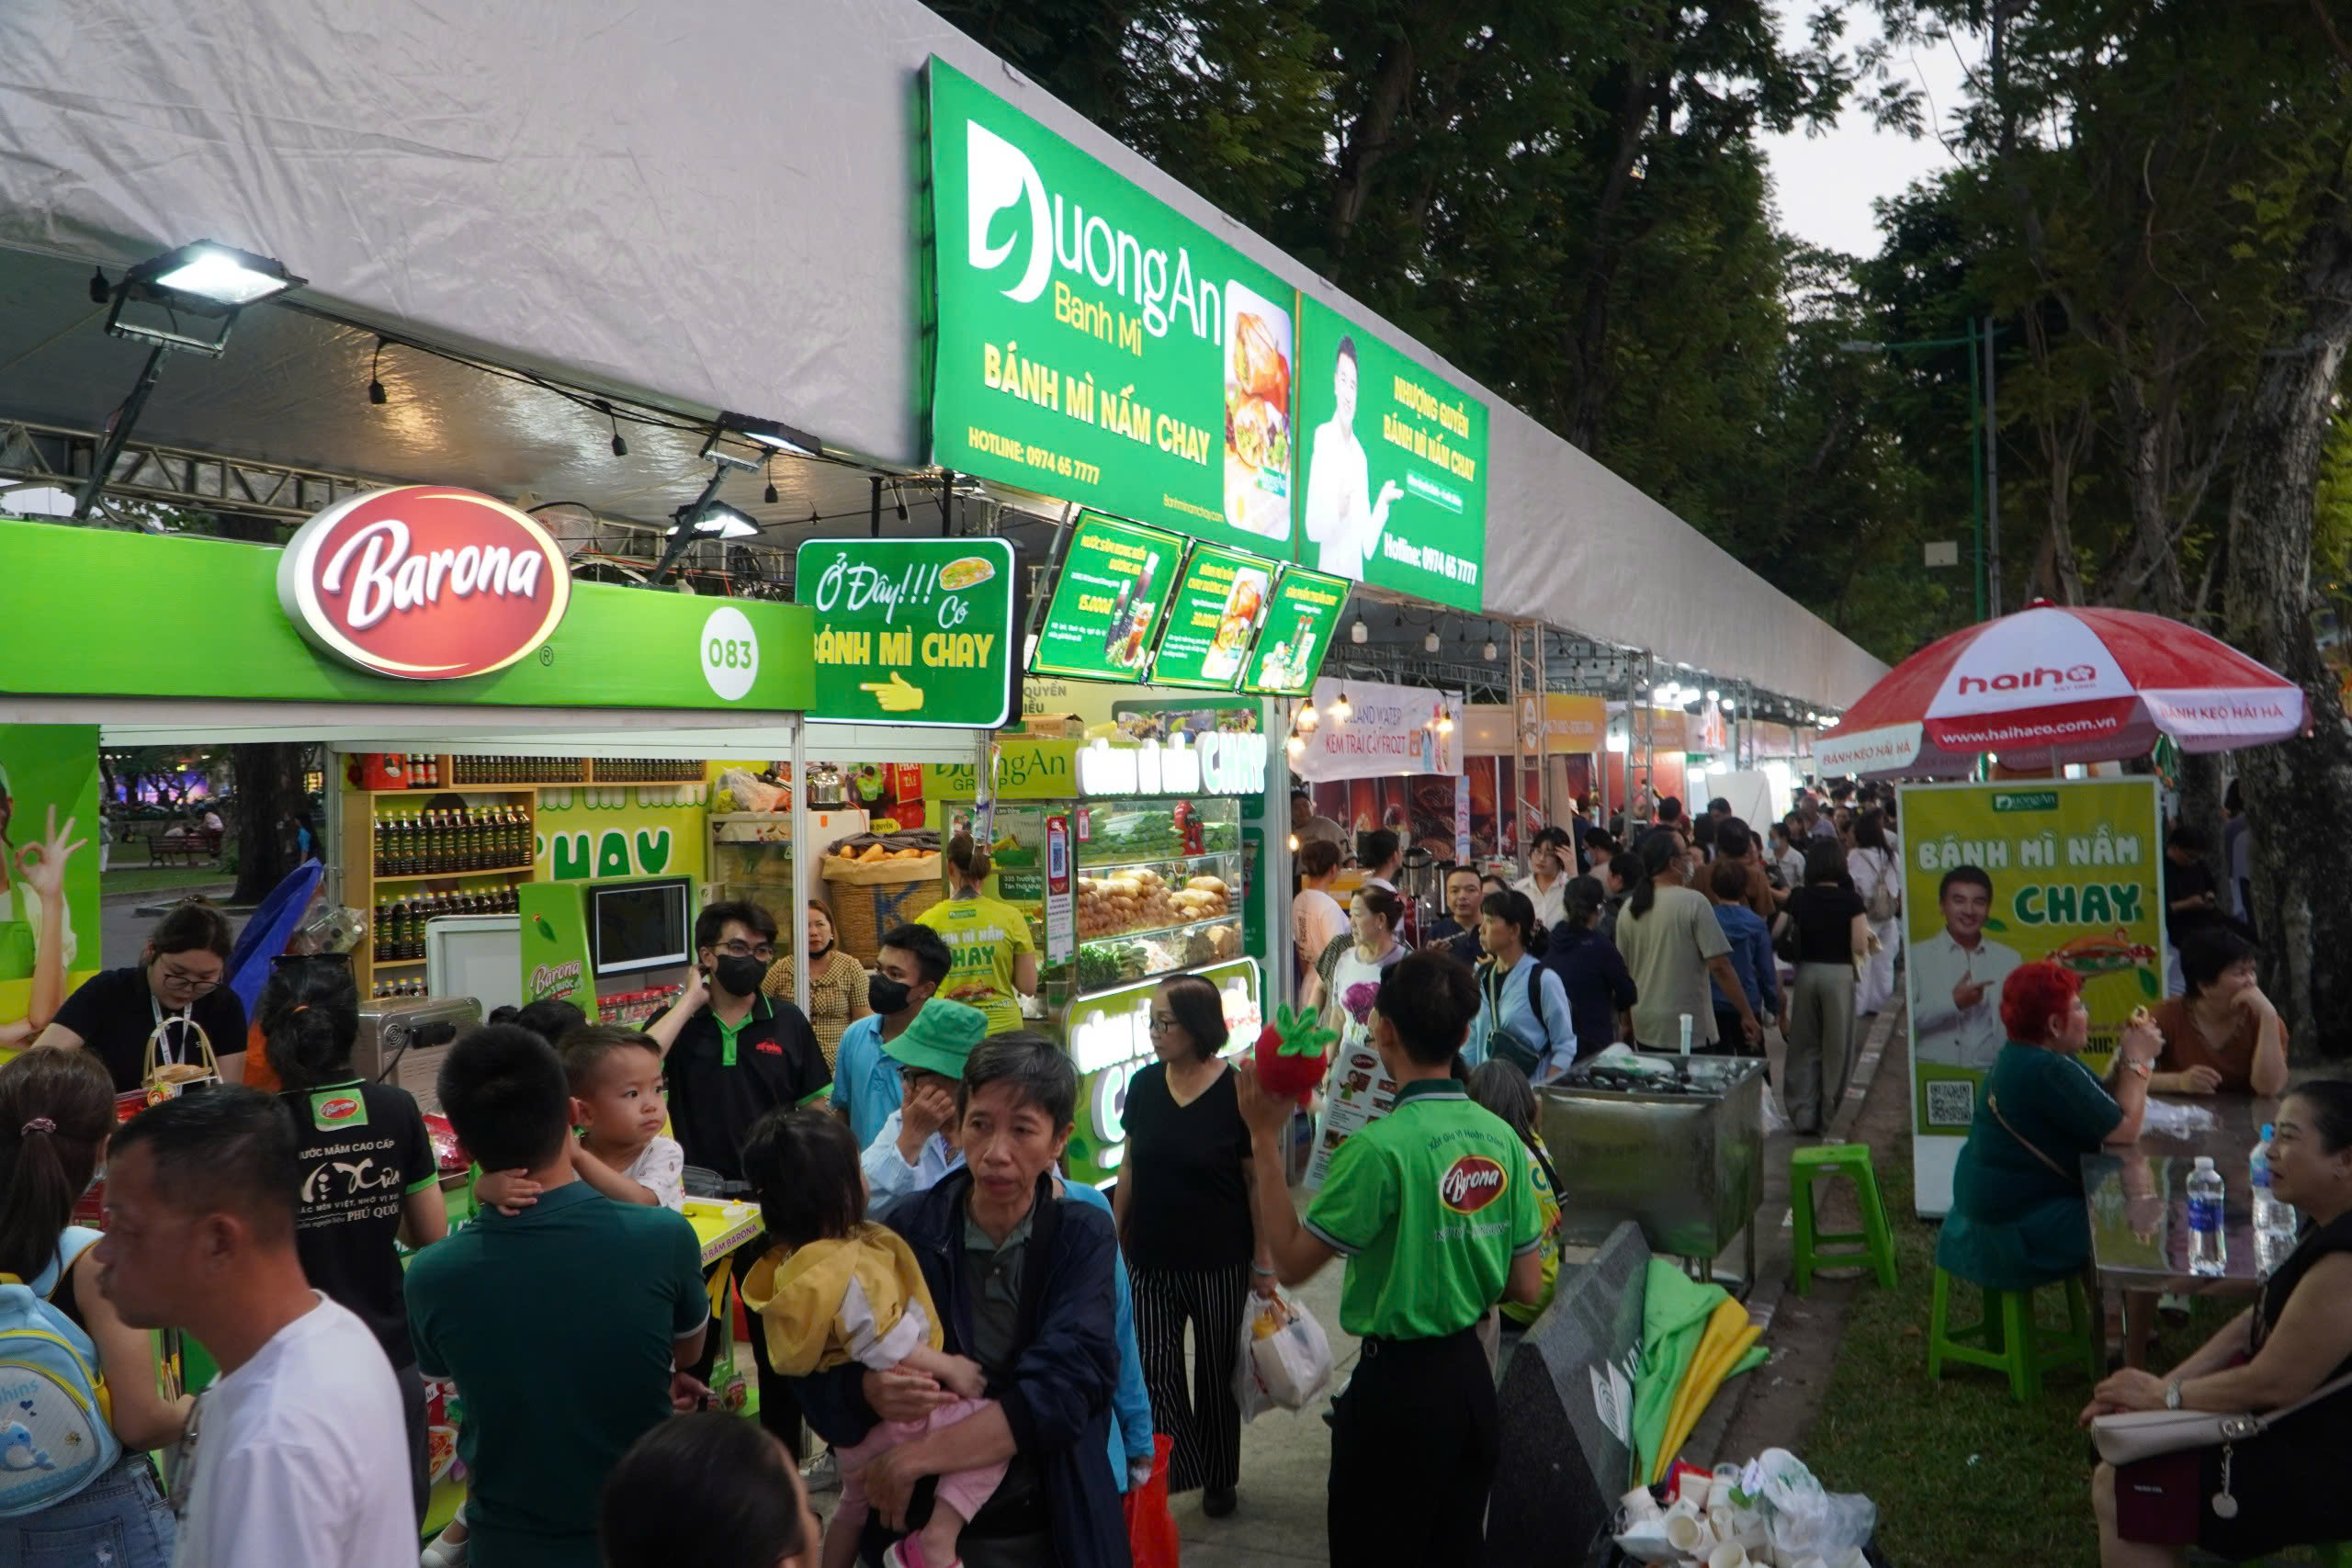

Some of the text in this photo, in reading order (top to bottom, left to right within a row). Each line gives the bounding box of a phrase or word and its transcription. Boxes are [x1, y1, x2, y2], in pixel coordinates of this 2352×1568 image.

[1055, 280, 1113, 344] Banh
[984, 340, 1211, 467] BÁNH MÌ NẤM CHAY
[968, 425, 1101, 485] HOTLINE: 0974 65 7777
[1383, 412, 1413, 452] BÁNH
[1428, 433, 1450, 470] NẤM
[322, 519, 543, 632] Barona
[816, 552, 849, 612] Ở
[937, 594, 969, 629] Có
[708, 637, 752, 669] 083
[878, 625, 912, 666] MÌ
[922, 632, 994, 668] CHAY
[1023, 681, 1068, 700] QUYỀN
[1959, 664, 2097, 695] haiha
[2161, 705, 2197, 720] BÁNH
[2261, 701, 2287, 719] HÀ
[1326, 734, 1344, 754] KEM
[1346, 728, 1365, 754] TRÁI
[1942, 716, 2117, 743] www.haihaco.com.vn
[935, 749, 1066, 785] ungAn
[953, 777, 1008, 791] GRUP
[537, 829, 671, 881] HAY
[1917, 833, 2009, 870] BÁNH
[2020, 830, 2056, 868] MÌ
[2015, 882, 2142, 926] CHAY
[952, 945, 995, 968] HAY
[529, 962, 582, 995] Barona
[300, 1137, 395, 1160] ƯỚC MẮM CAO CẤP
[346, 1207, 371, 1223] PHÚ
[373, 1201, 399, 1219] QUỐ
[726, 1224, 758, 1247] BARONA
